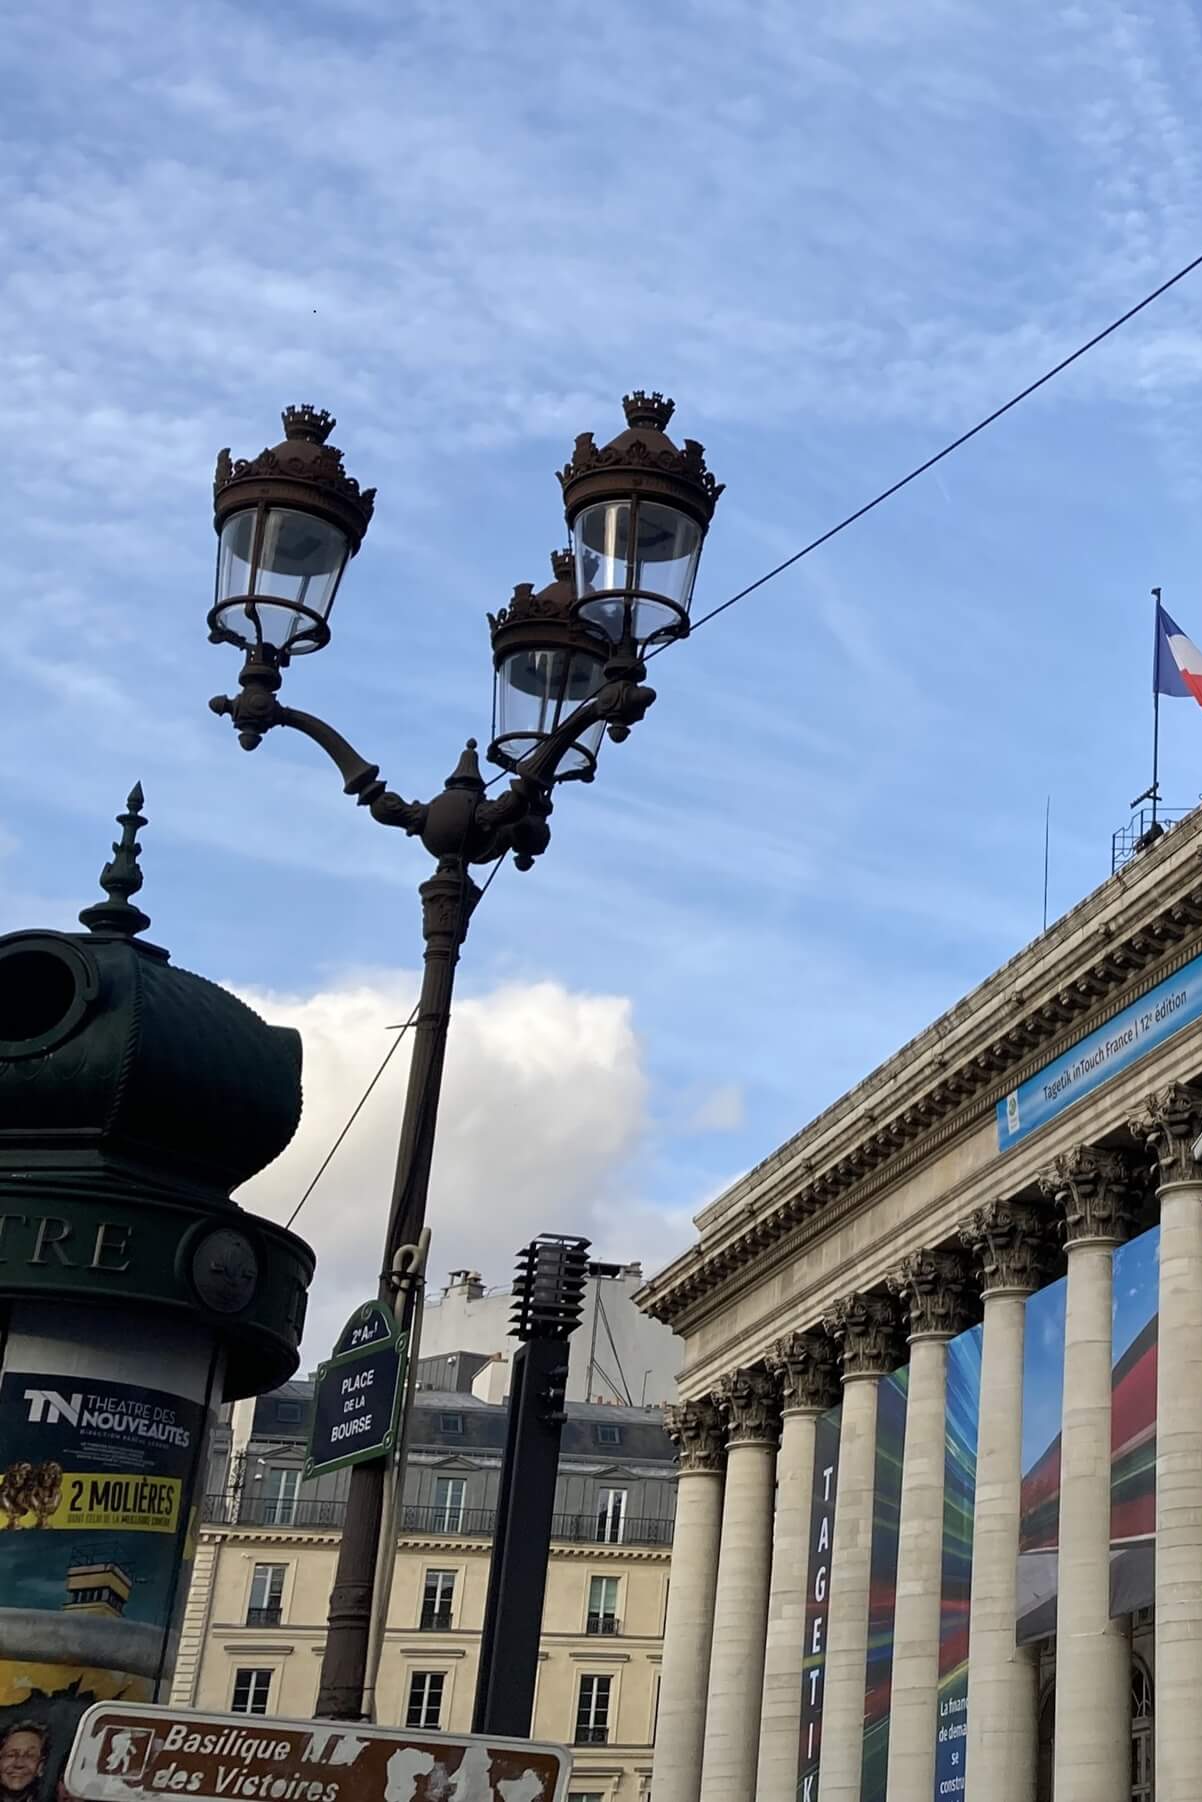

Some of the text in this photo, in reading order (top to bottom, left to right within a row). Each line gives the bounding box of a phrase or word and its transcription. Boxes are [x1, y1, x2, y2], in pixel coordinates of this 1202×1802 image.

[1043, 1071, 1071, 1101] Tagetik
[1073, 1047, 1104, 1078] inTouch
[1105, 1028, 1133, 1057] France
[1155, 990, 1187, 1023] édition
[341, 1369, 375, 1394] PLACE
[24, 1389, 83, 1428] TN
[153, 1406, 176, 1425] DES
[343, 1395, 365, 1413] DE LA
[81, 1411, 191, 1448] NOUVEAUTÉS
[330, 1414, 373, 1442] BOURSE
[69, 1477, 175, 1515] 2 MOLIÈRES
[940, 1701, 948, 1717] La
[163, 1724, 291, 1765] Basilique
[939, 1726, 948, 1742] de
[151, 1762, 340, 1802] des Victoires
